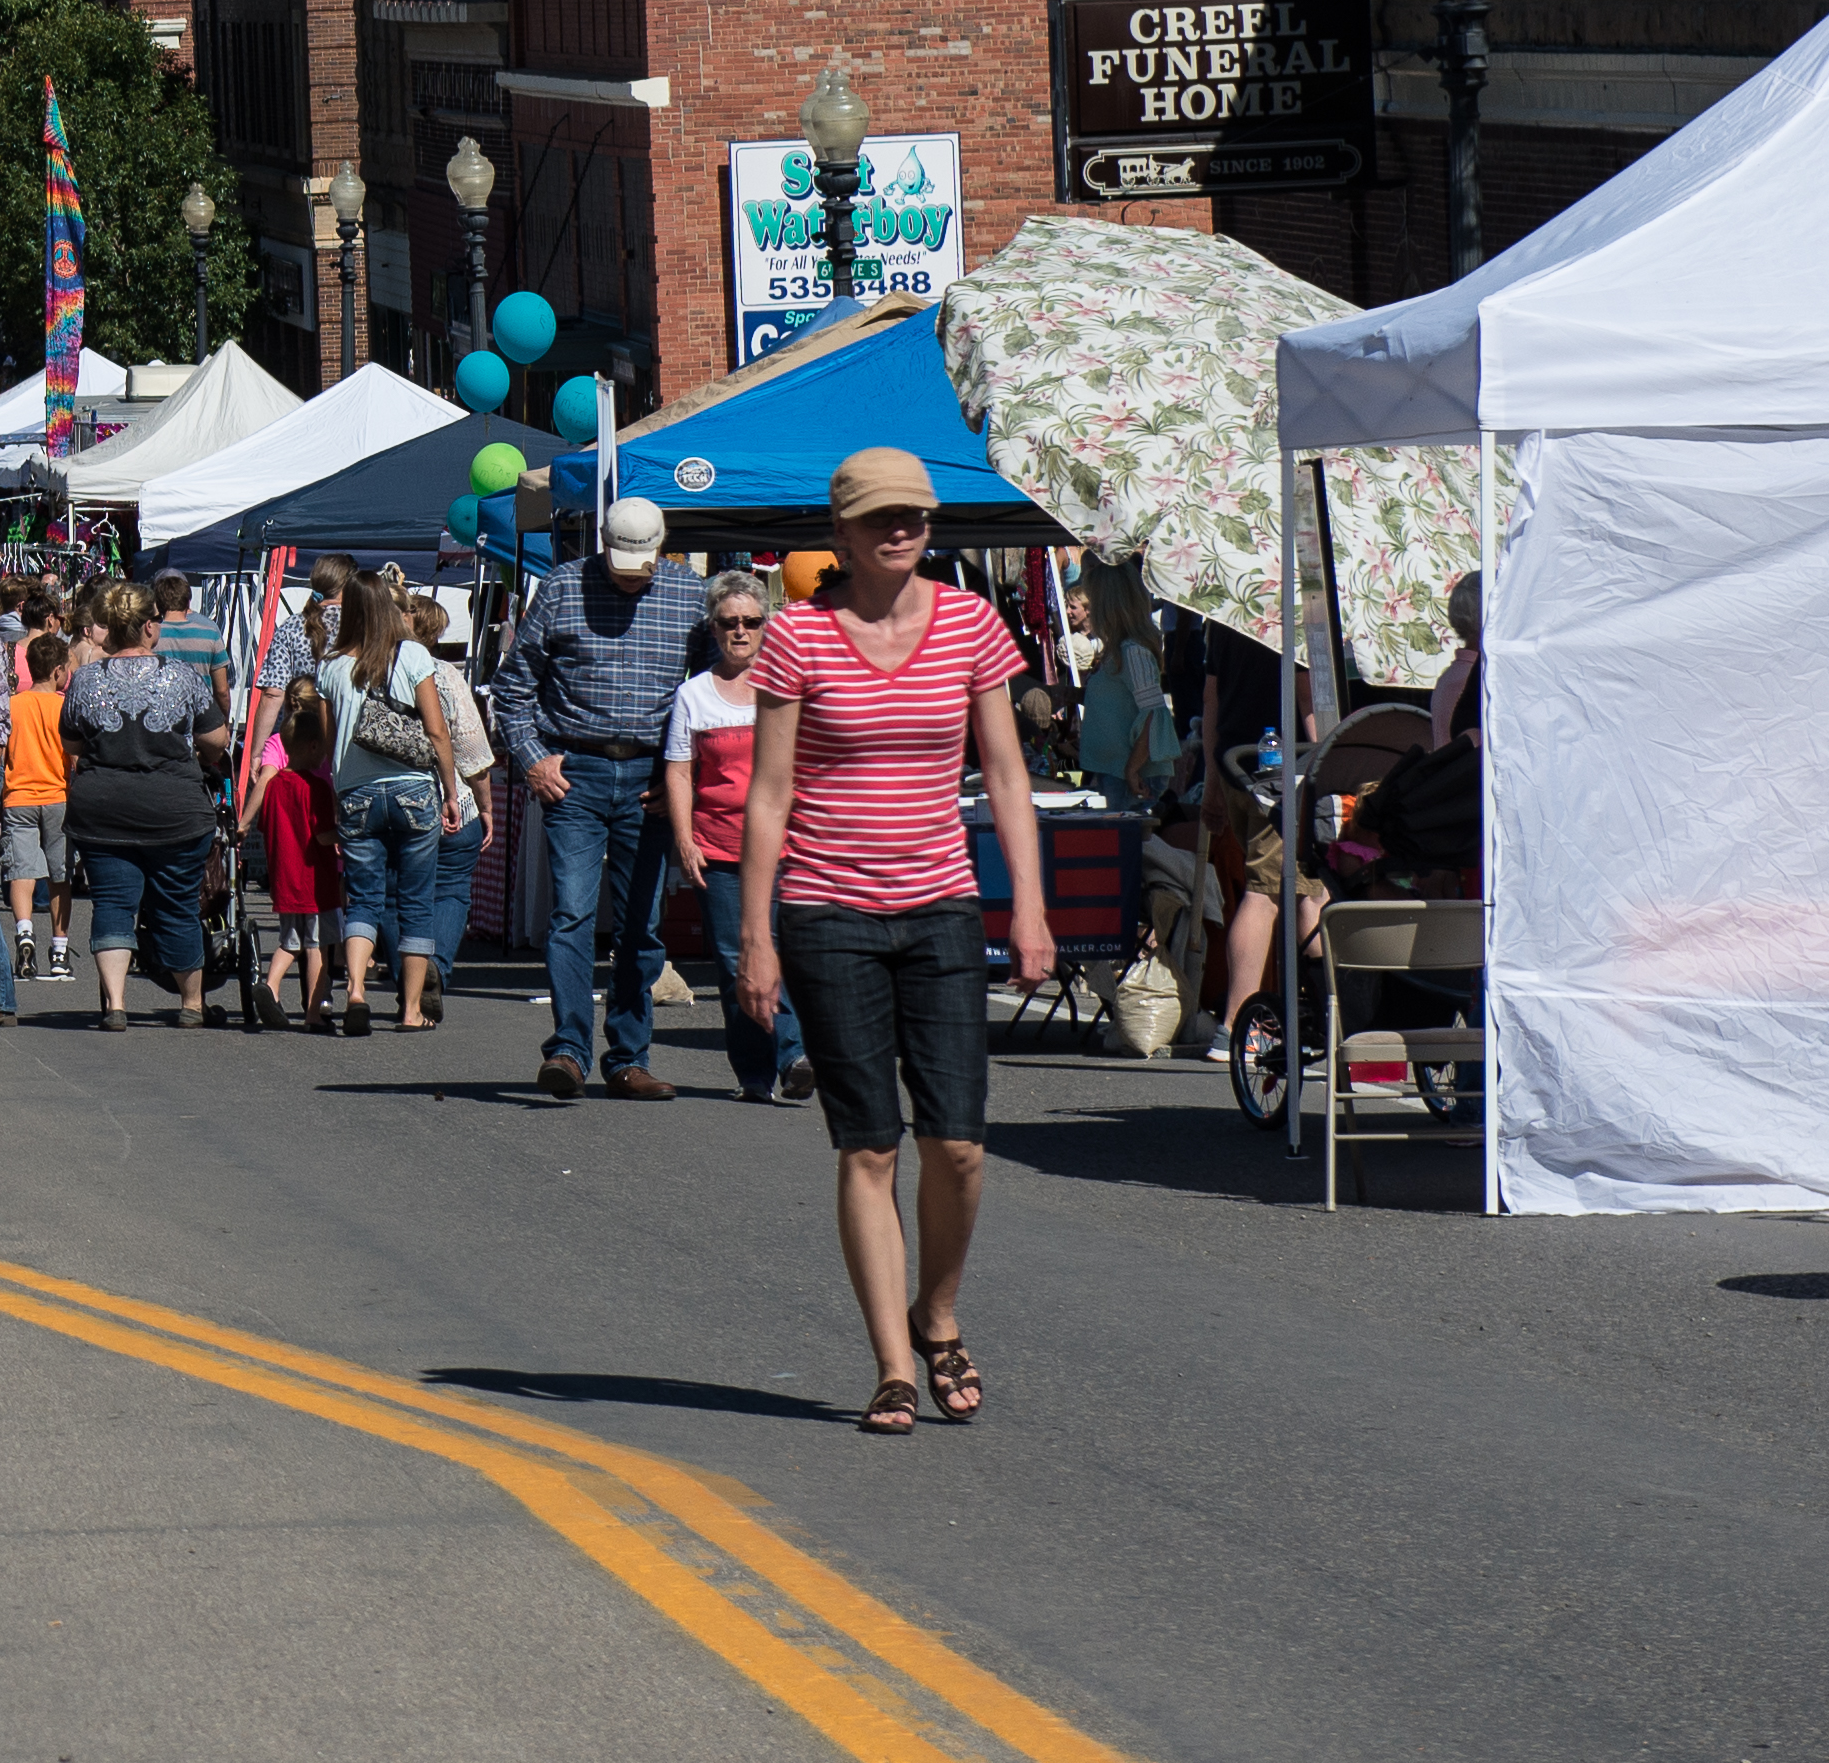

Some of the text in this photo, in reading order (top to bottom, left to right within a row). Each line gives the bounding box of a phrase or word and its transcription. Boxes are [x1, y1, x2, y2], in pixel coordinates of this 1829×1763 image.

[1129, 3, 1306, 43] CREEL
[1087, 40, 1351, 84] FUNERAL
[1140, 81, 1303, 122] HOME
[1209, 155, 1326, 175] SINCE 1902
[743, 196, 953, 251] Watrboy
[791, 255, 808, 270] All
[870, 263, 879, 276] S
